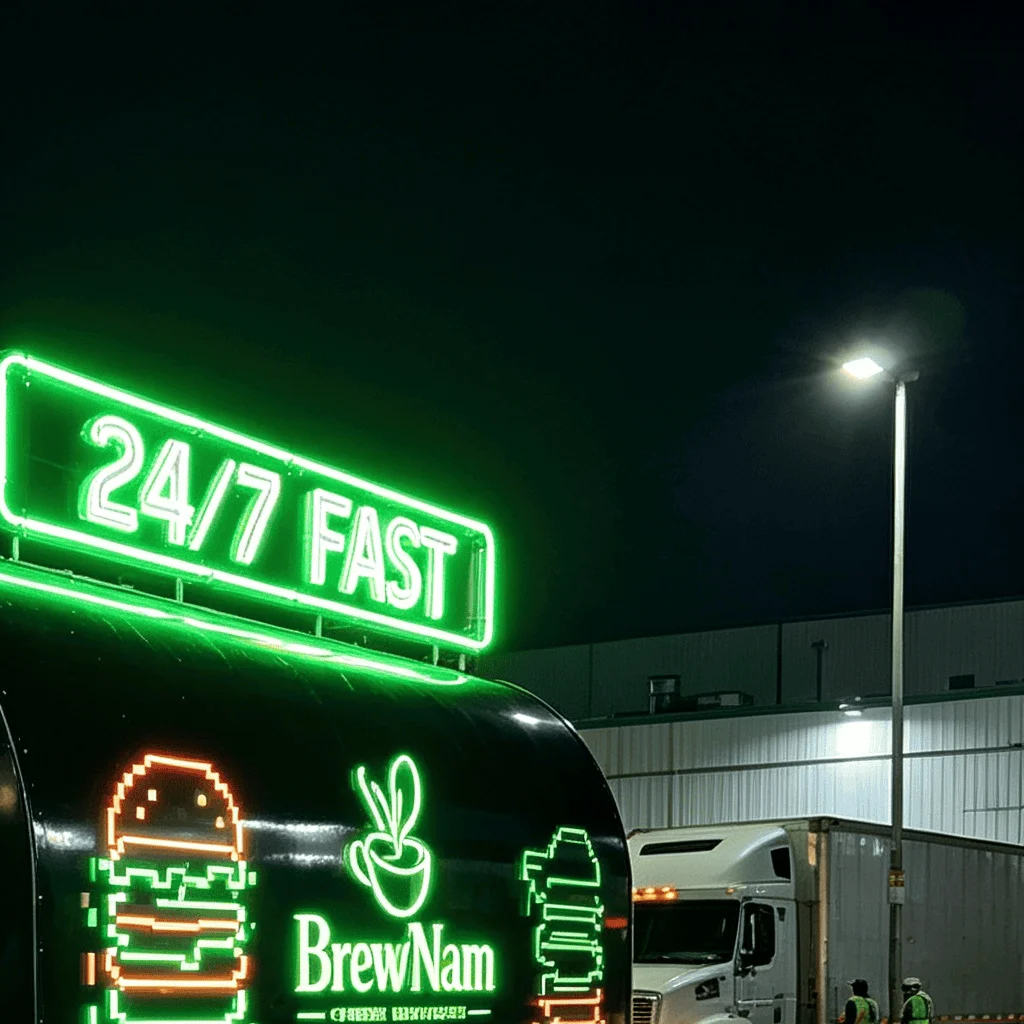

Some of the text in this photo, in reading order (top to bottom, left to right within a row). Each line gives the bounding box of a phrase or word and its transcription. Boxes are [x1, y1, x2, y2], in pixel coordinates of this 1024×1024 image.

[80, 414, 458, 619] 24/7 FAST
[293, 913, 496, 993] BrewNam
